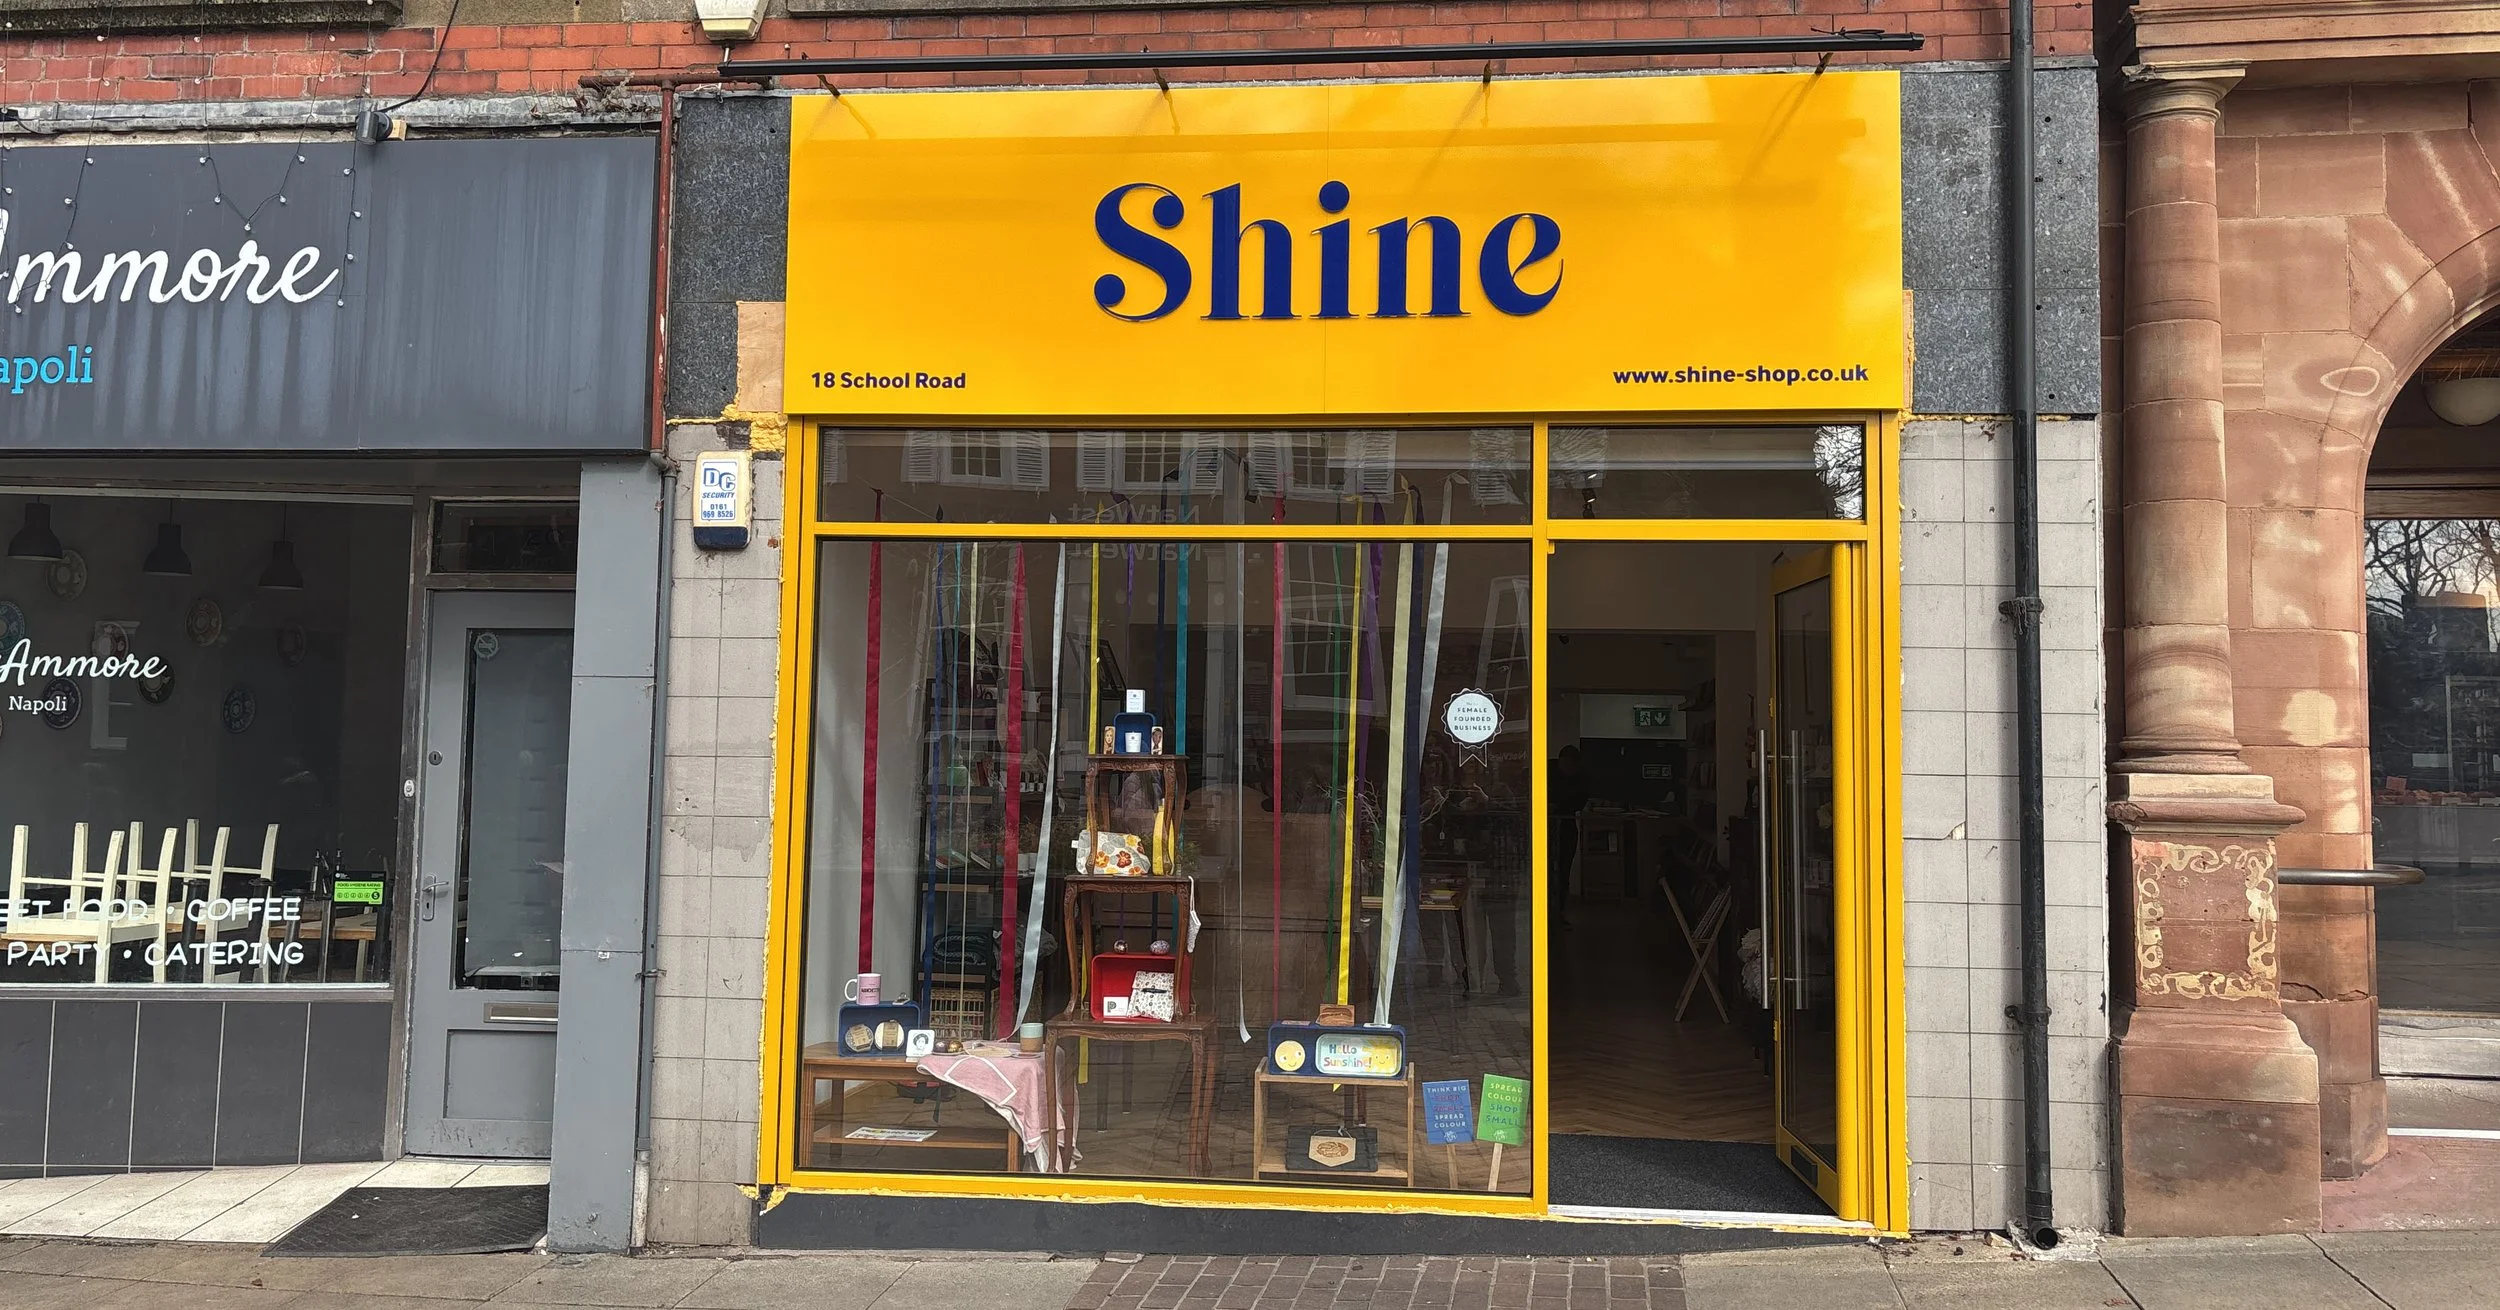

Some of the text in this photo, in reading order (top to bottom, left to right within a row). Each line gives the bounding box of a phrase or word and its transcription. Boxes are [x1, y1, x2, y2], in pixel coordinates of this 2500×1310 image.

[0, 208, 340, 304] mmore
[1093, 179, 1565, 323] Shine
[811, 371, 967, 389] 18 School Road
[1612, 364, 1870, 387] www.shine-shop.co.uk
[703, 468, 736, 491] DC
[8, 695, 68, 715] Napoli
[186, 897, 301, 922] COFFEE
[7, 940, 305, 966] PARTY CATERING
[1329, 1044, 1358, 1055] Hello
[1323, 1056, 1373, 1069] Sunshine!
[1427, 1086, 1451, 1094] THINK
[1490, 1083, 1523, 1093] SPREAD
[1487, 1092, 1523, 1103] COLOUR
[1490, 1103, 1519, 1114] SHOP
[1434, 1113, 1464, 1121] SPREAD
[1486, 1115, 1519, 1127] SMALL
[1434, 1121, 1466, 1129] COLOUR
